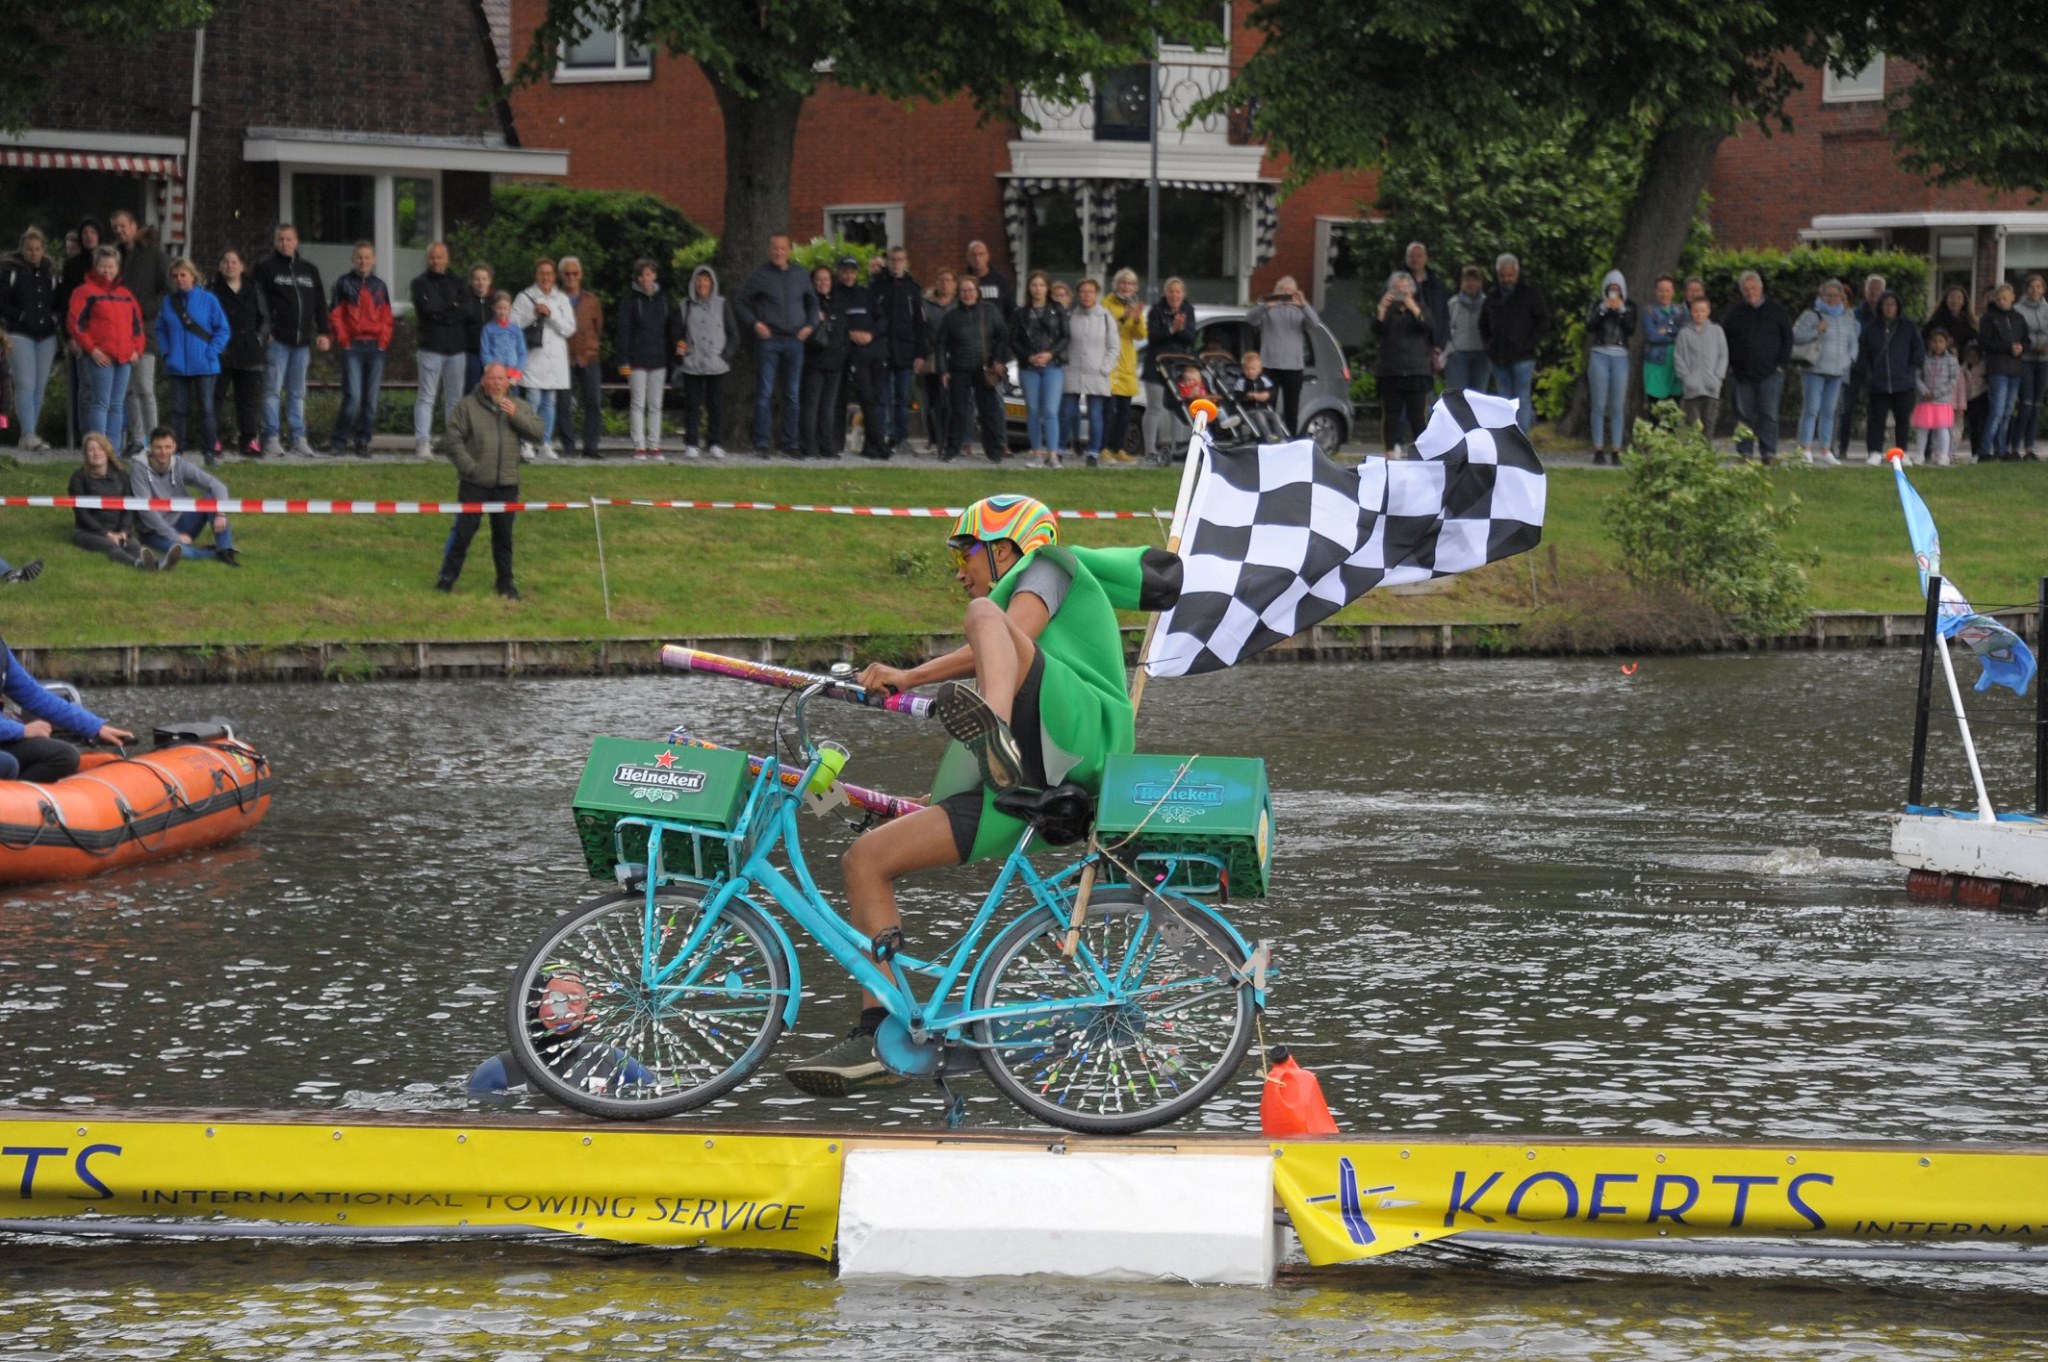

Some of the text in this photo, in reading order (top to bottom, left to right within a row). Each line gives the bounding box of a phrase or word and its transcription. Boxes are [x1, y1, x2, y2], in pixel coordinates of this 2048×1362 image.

[618, 767, 699, 788] Heineken
[1, 1143, 805, 1231] TS INTERNATIONAL TOWING SERVICE
[1443, 1170, 2048, 1235] KOERTS INTERNA
